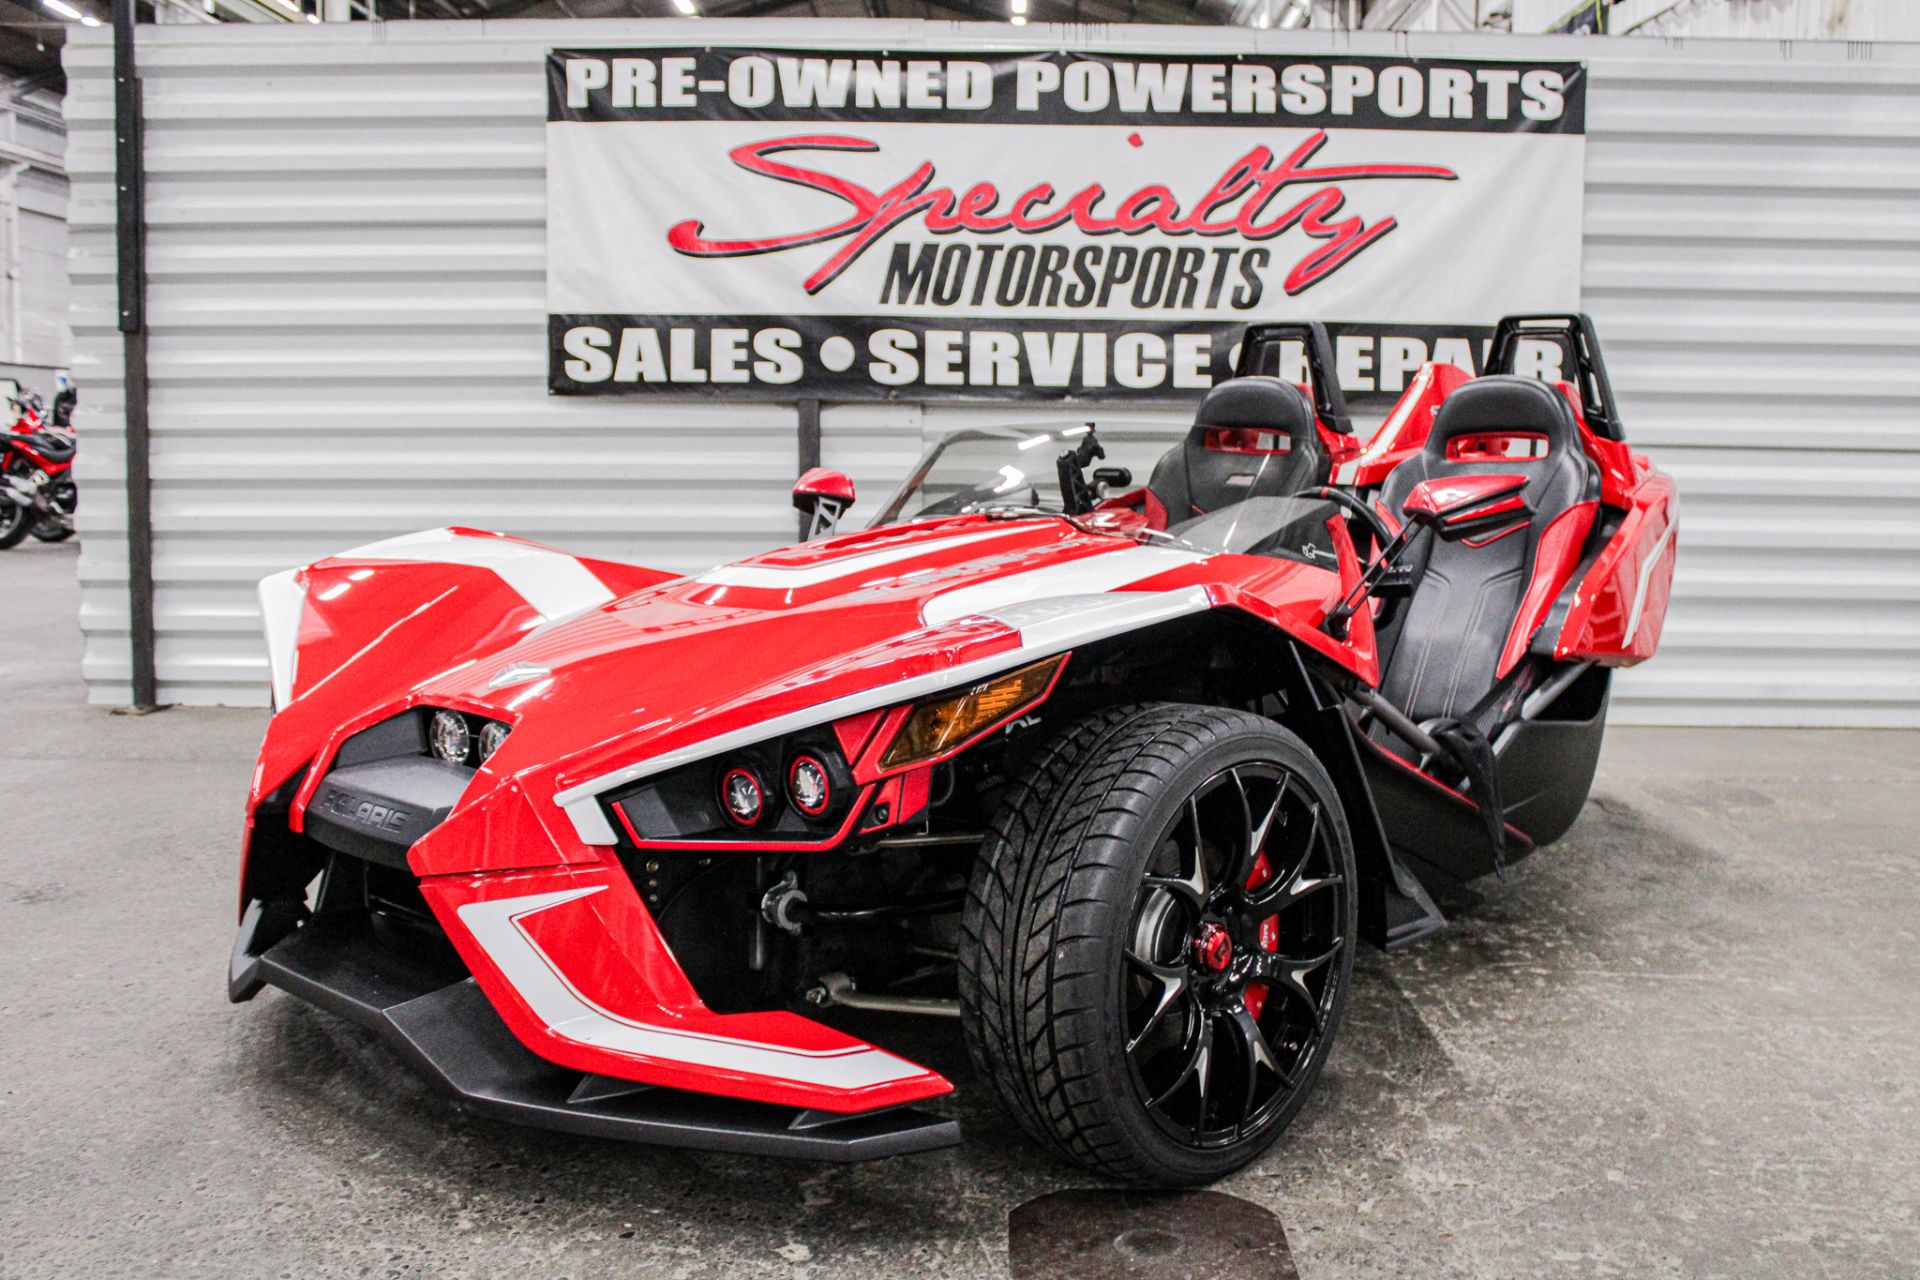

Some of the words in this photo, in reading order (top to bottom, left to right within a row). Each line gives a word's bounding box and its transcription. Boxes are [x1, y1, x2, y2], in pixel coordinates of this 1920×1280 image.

[566, 56, 993, 110] PRE-OWNED
[1016, 60, 1564, 121] POWERSPORTS
[667, 129, 1459, 295] Specialty
[878, 242, 1271, 310] MOTORSPORTS
[564, 326, 804, 385] SALES
[868, 328, 1212, 388] SERVICE
